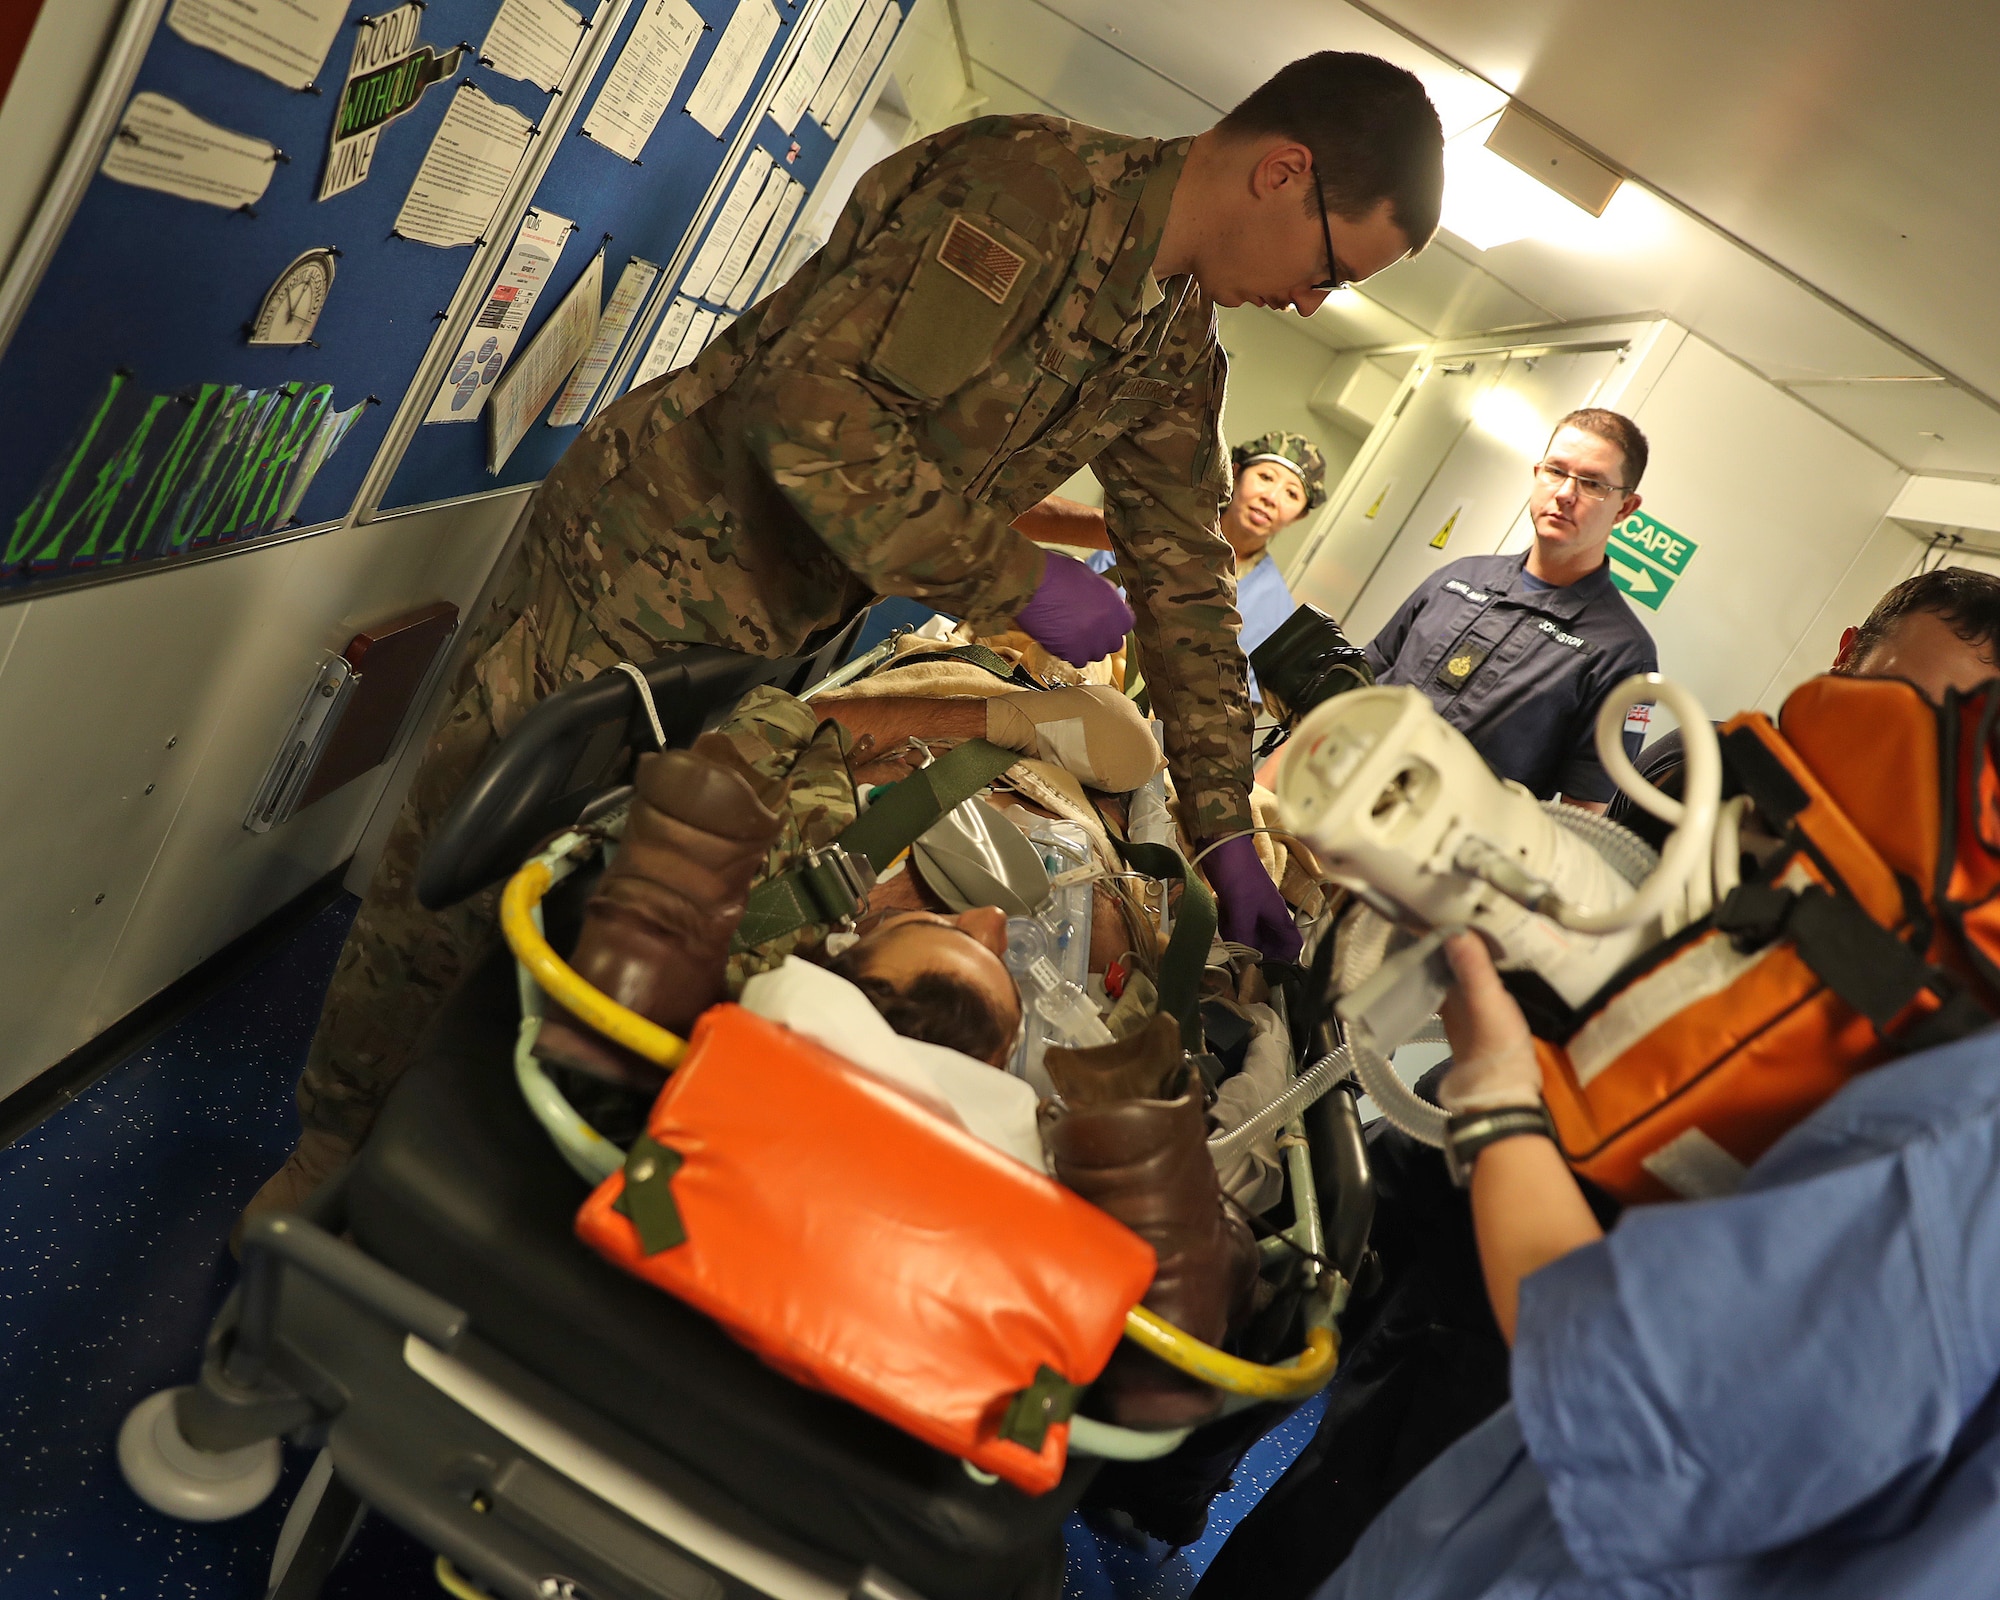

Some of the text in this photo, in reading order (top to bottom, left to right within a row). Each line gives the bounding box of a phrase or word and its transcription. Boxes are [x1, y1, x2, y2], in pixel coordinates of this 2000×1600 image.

[352, 5, 419, 74] WORLD
[338, 56, 426, 135] WITHOUT
[322, 132, 376, 197] WINE
[1613, 514, 1688, 567] CAPE
